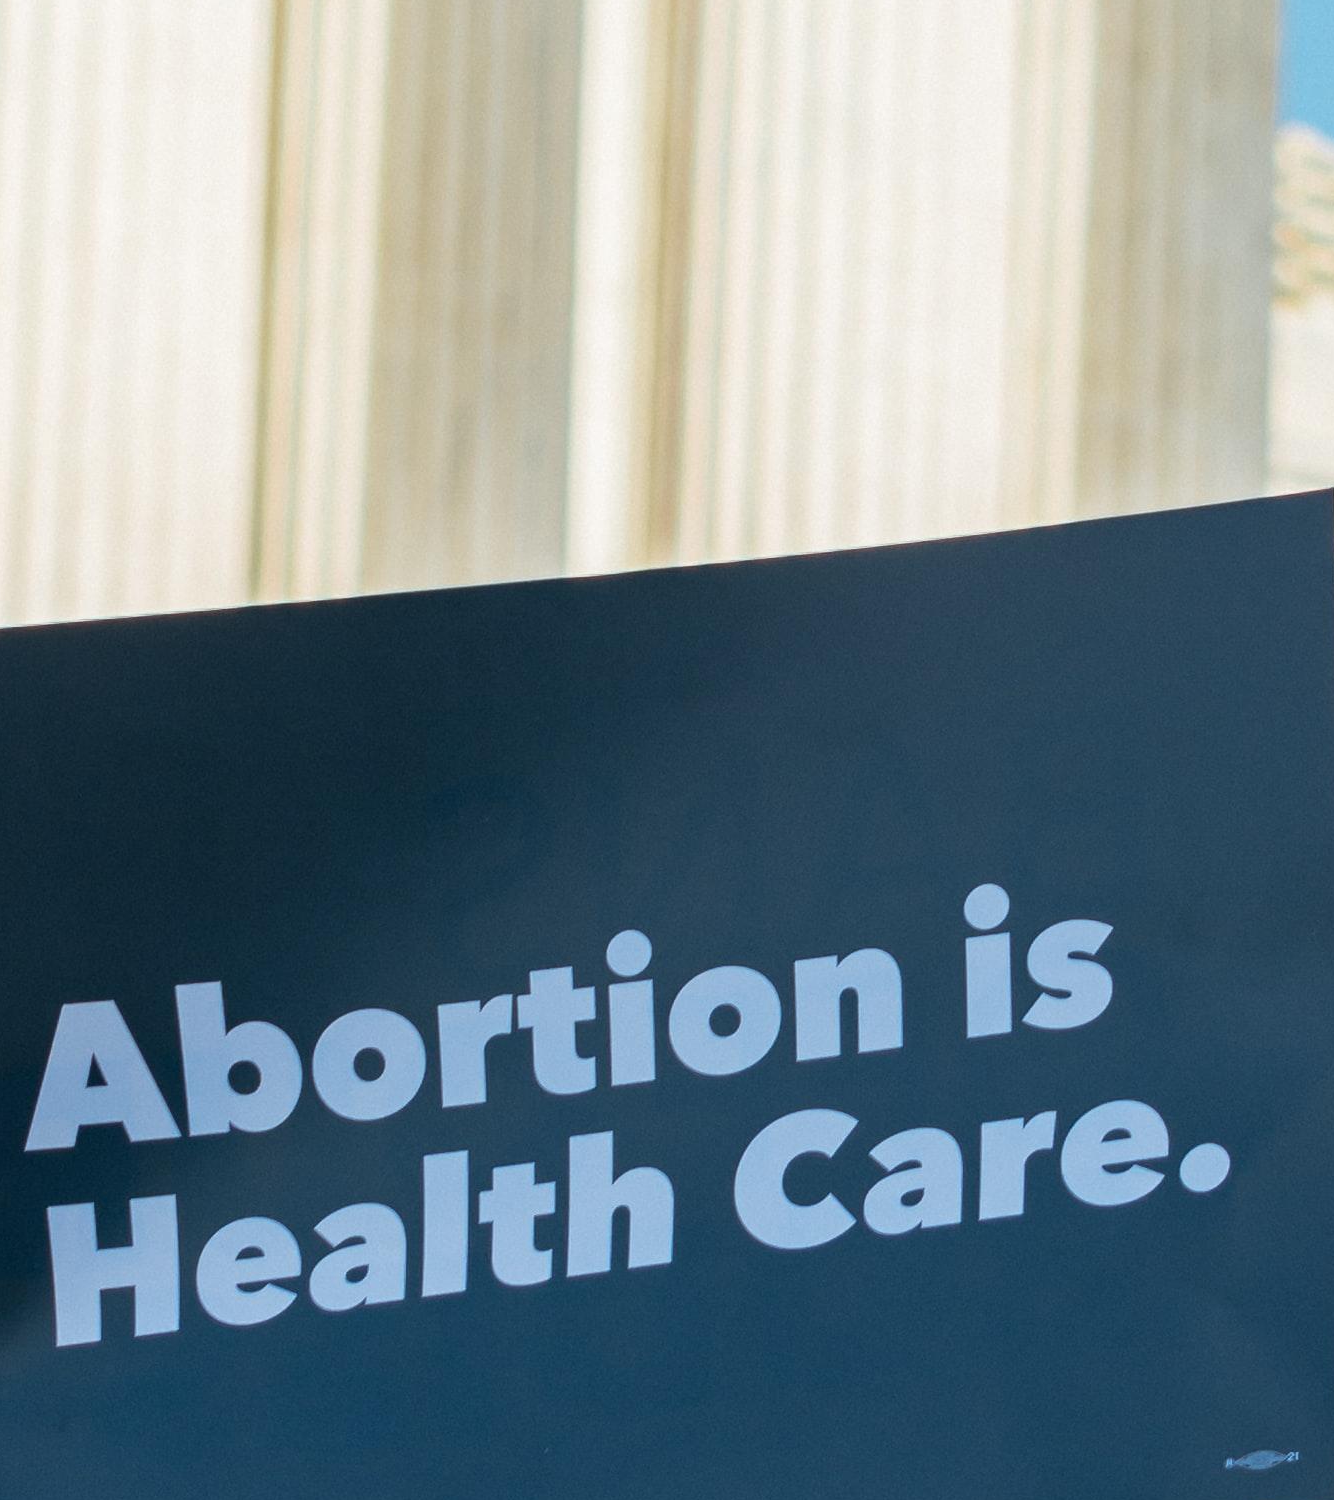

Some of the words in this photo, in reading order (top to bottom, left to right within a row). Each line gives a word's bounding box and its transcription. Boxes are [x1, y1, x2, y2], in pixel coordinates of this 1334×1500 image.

[24, 928, 904, 1152] Abortion
[962, 882, 1115, 1039] is
[46, 1129, 675, 1348] Health
[733, 1099, 1232, 1251] Care.
